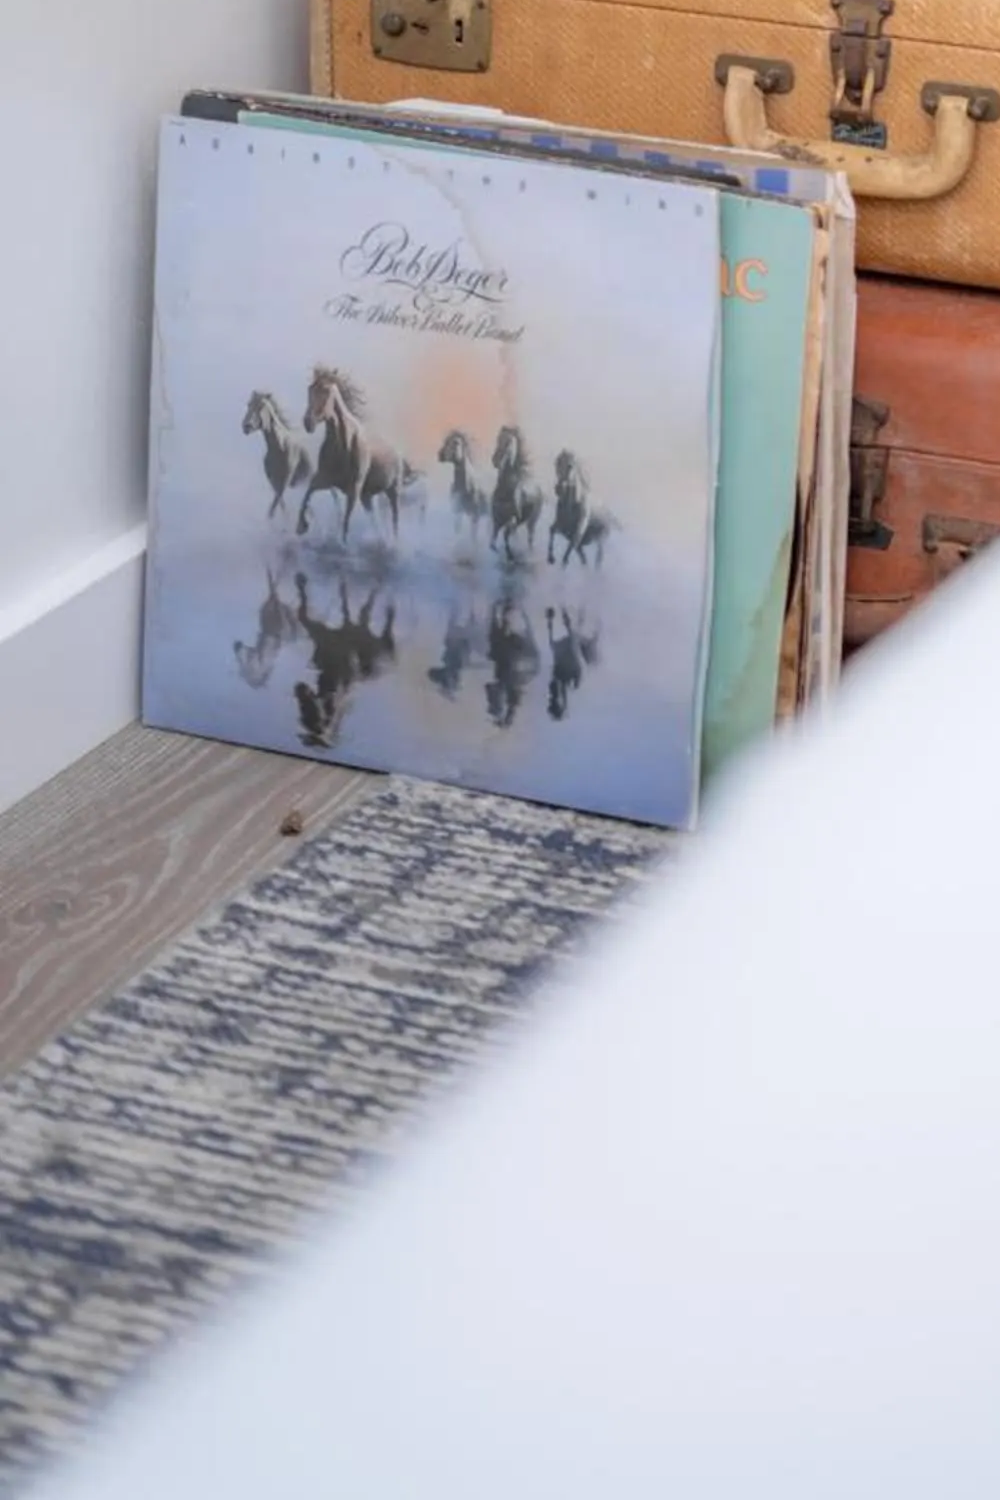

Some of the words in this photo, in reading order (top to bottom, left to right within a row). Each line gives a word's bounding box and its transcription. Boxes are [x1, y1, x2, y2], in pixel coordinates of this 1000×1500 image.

[339, 221, 427, 279] Bob
[418, 237, 509, 302] Seger
[323, 293, 362, 321] The
